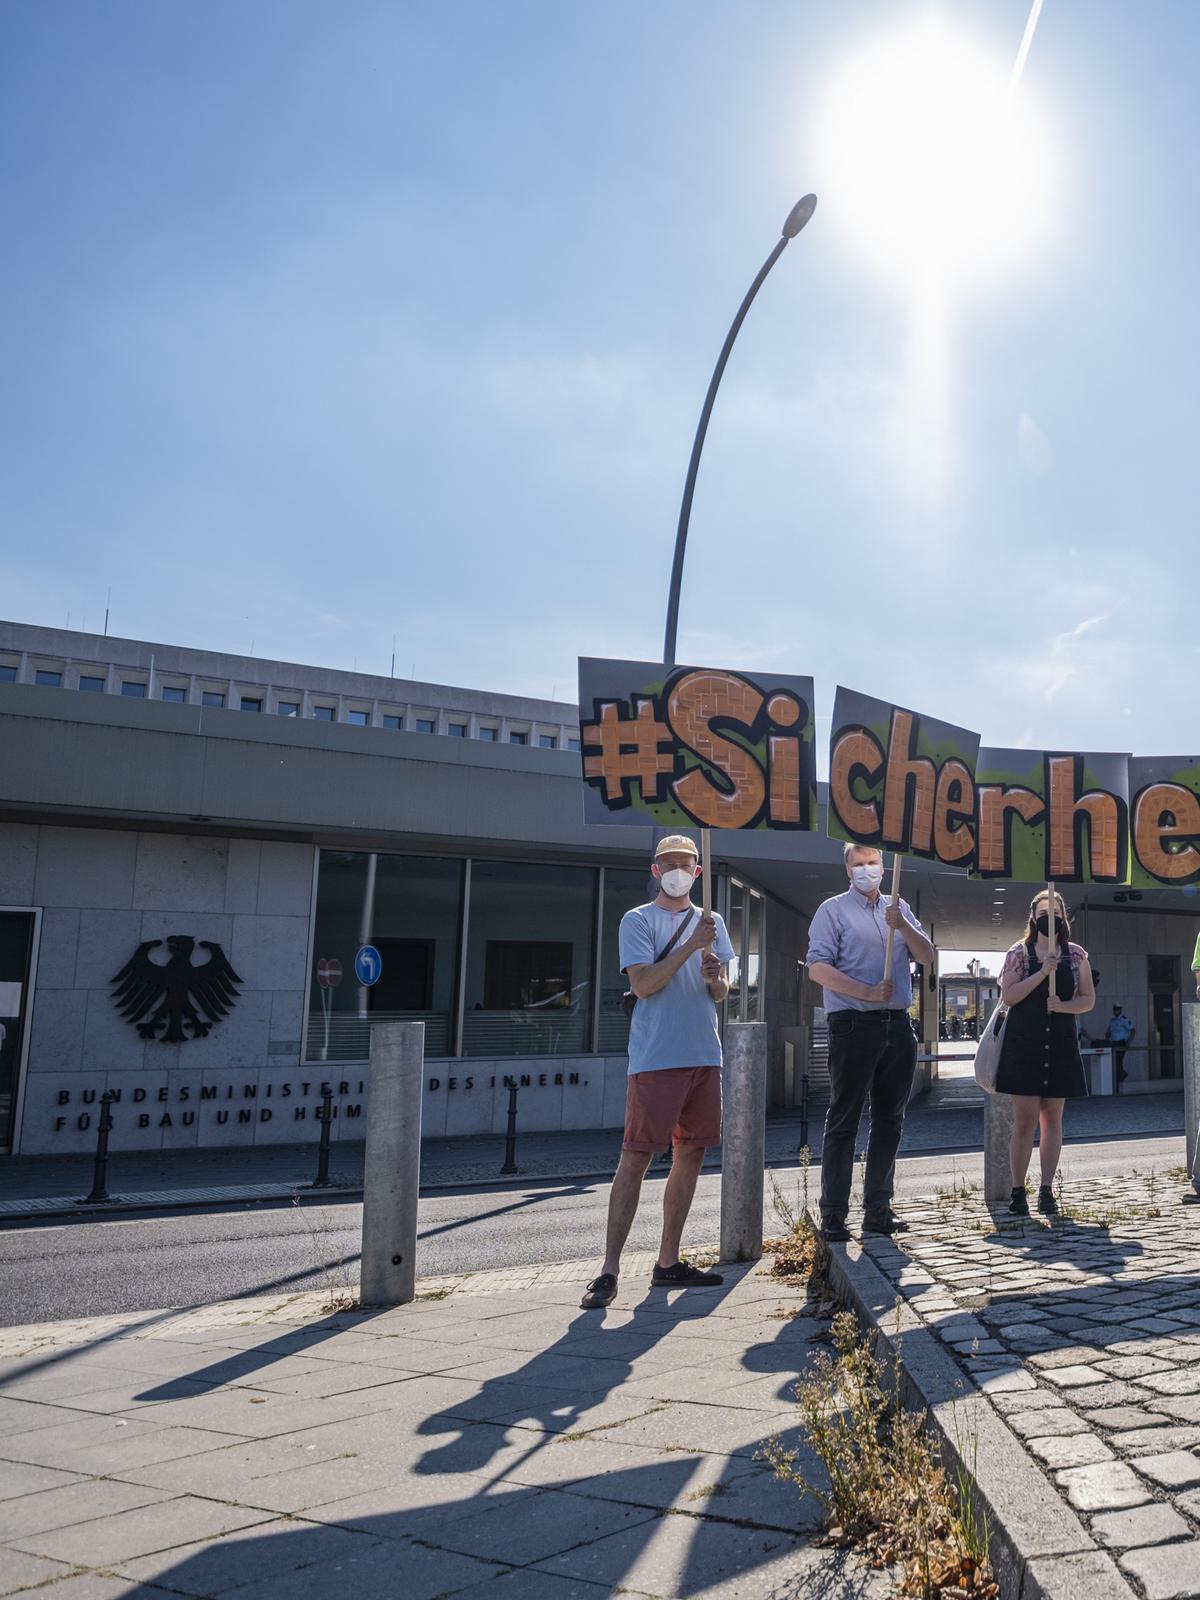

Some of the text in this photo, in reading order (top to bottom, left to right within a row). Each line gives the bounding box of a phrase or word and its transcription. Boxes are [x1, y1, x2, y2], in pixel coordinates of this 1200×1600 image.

[57, 1071, 589, 1106] BUNDESMINISTERI DES INNERN,
[138, 1111, 196, 1129] BAU
[216, 1107, 273, 1125] UND
[294, 1104, 362, 1121] HEIM
